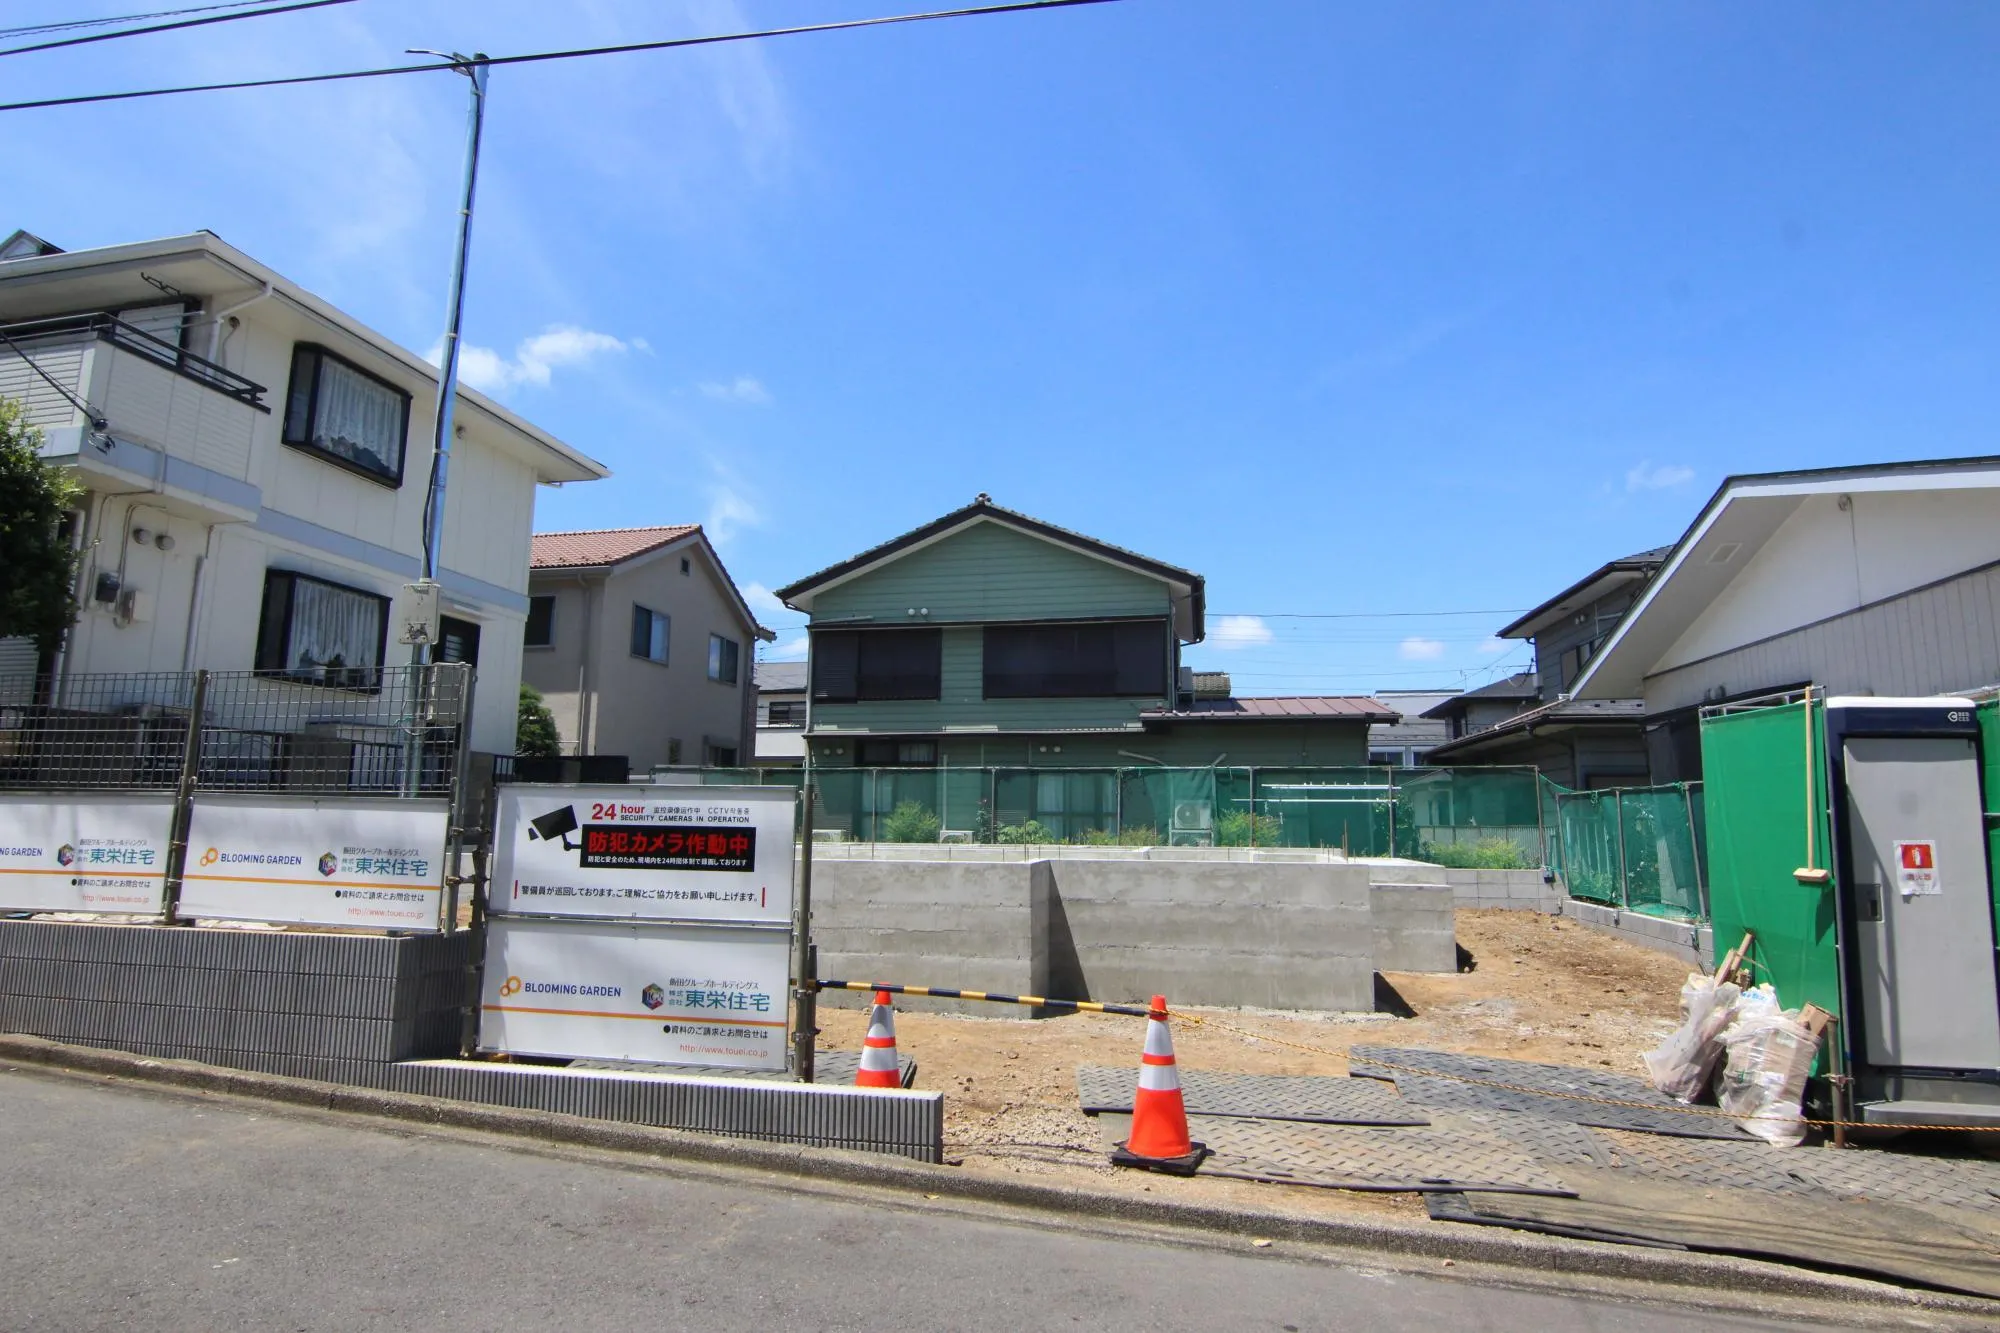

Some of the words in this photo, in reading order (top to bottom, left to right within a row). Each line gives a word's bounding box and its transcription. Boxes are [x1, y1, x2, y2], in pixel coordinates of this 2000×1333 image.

[591, 803, 617, 820] 24
[621, 804, 645, 814] hour
[588, 831, 749, 855] 防犯カメラ作動中
[11, 847, 43, 857] GARDEN
[89, 848, 156, 865] 東栄住宅
[220, 853, 264, 863] BLOOMING
[266, 855, 302, 865] GARDEN
[355, 857, 428, 877] 東栄住宅
[525, 982, 577, 994] BLOOMING
[579, 985, 621, 997] GARDEN
[685, 989, 770, 1012] 東栄住宅
[671, 1024, 768, 1039] 資料のご請求とお問合せは
[680, 1044, 768, 1058] http://www.touei.co.jp
